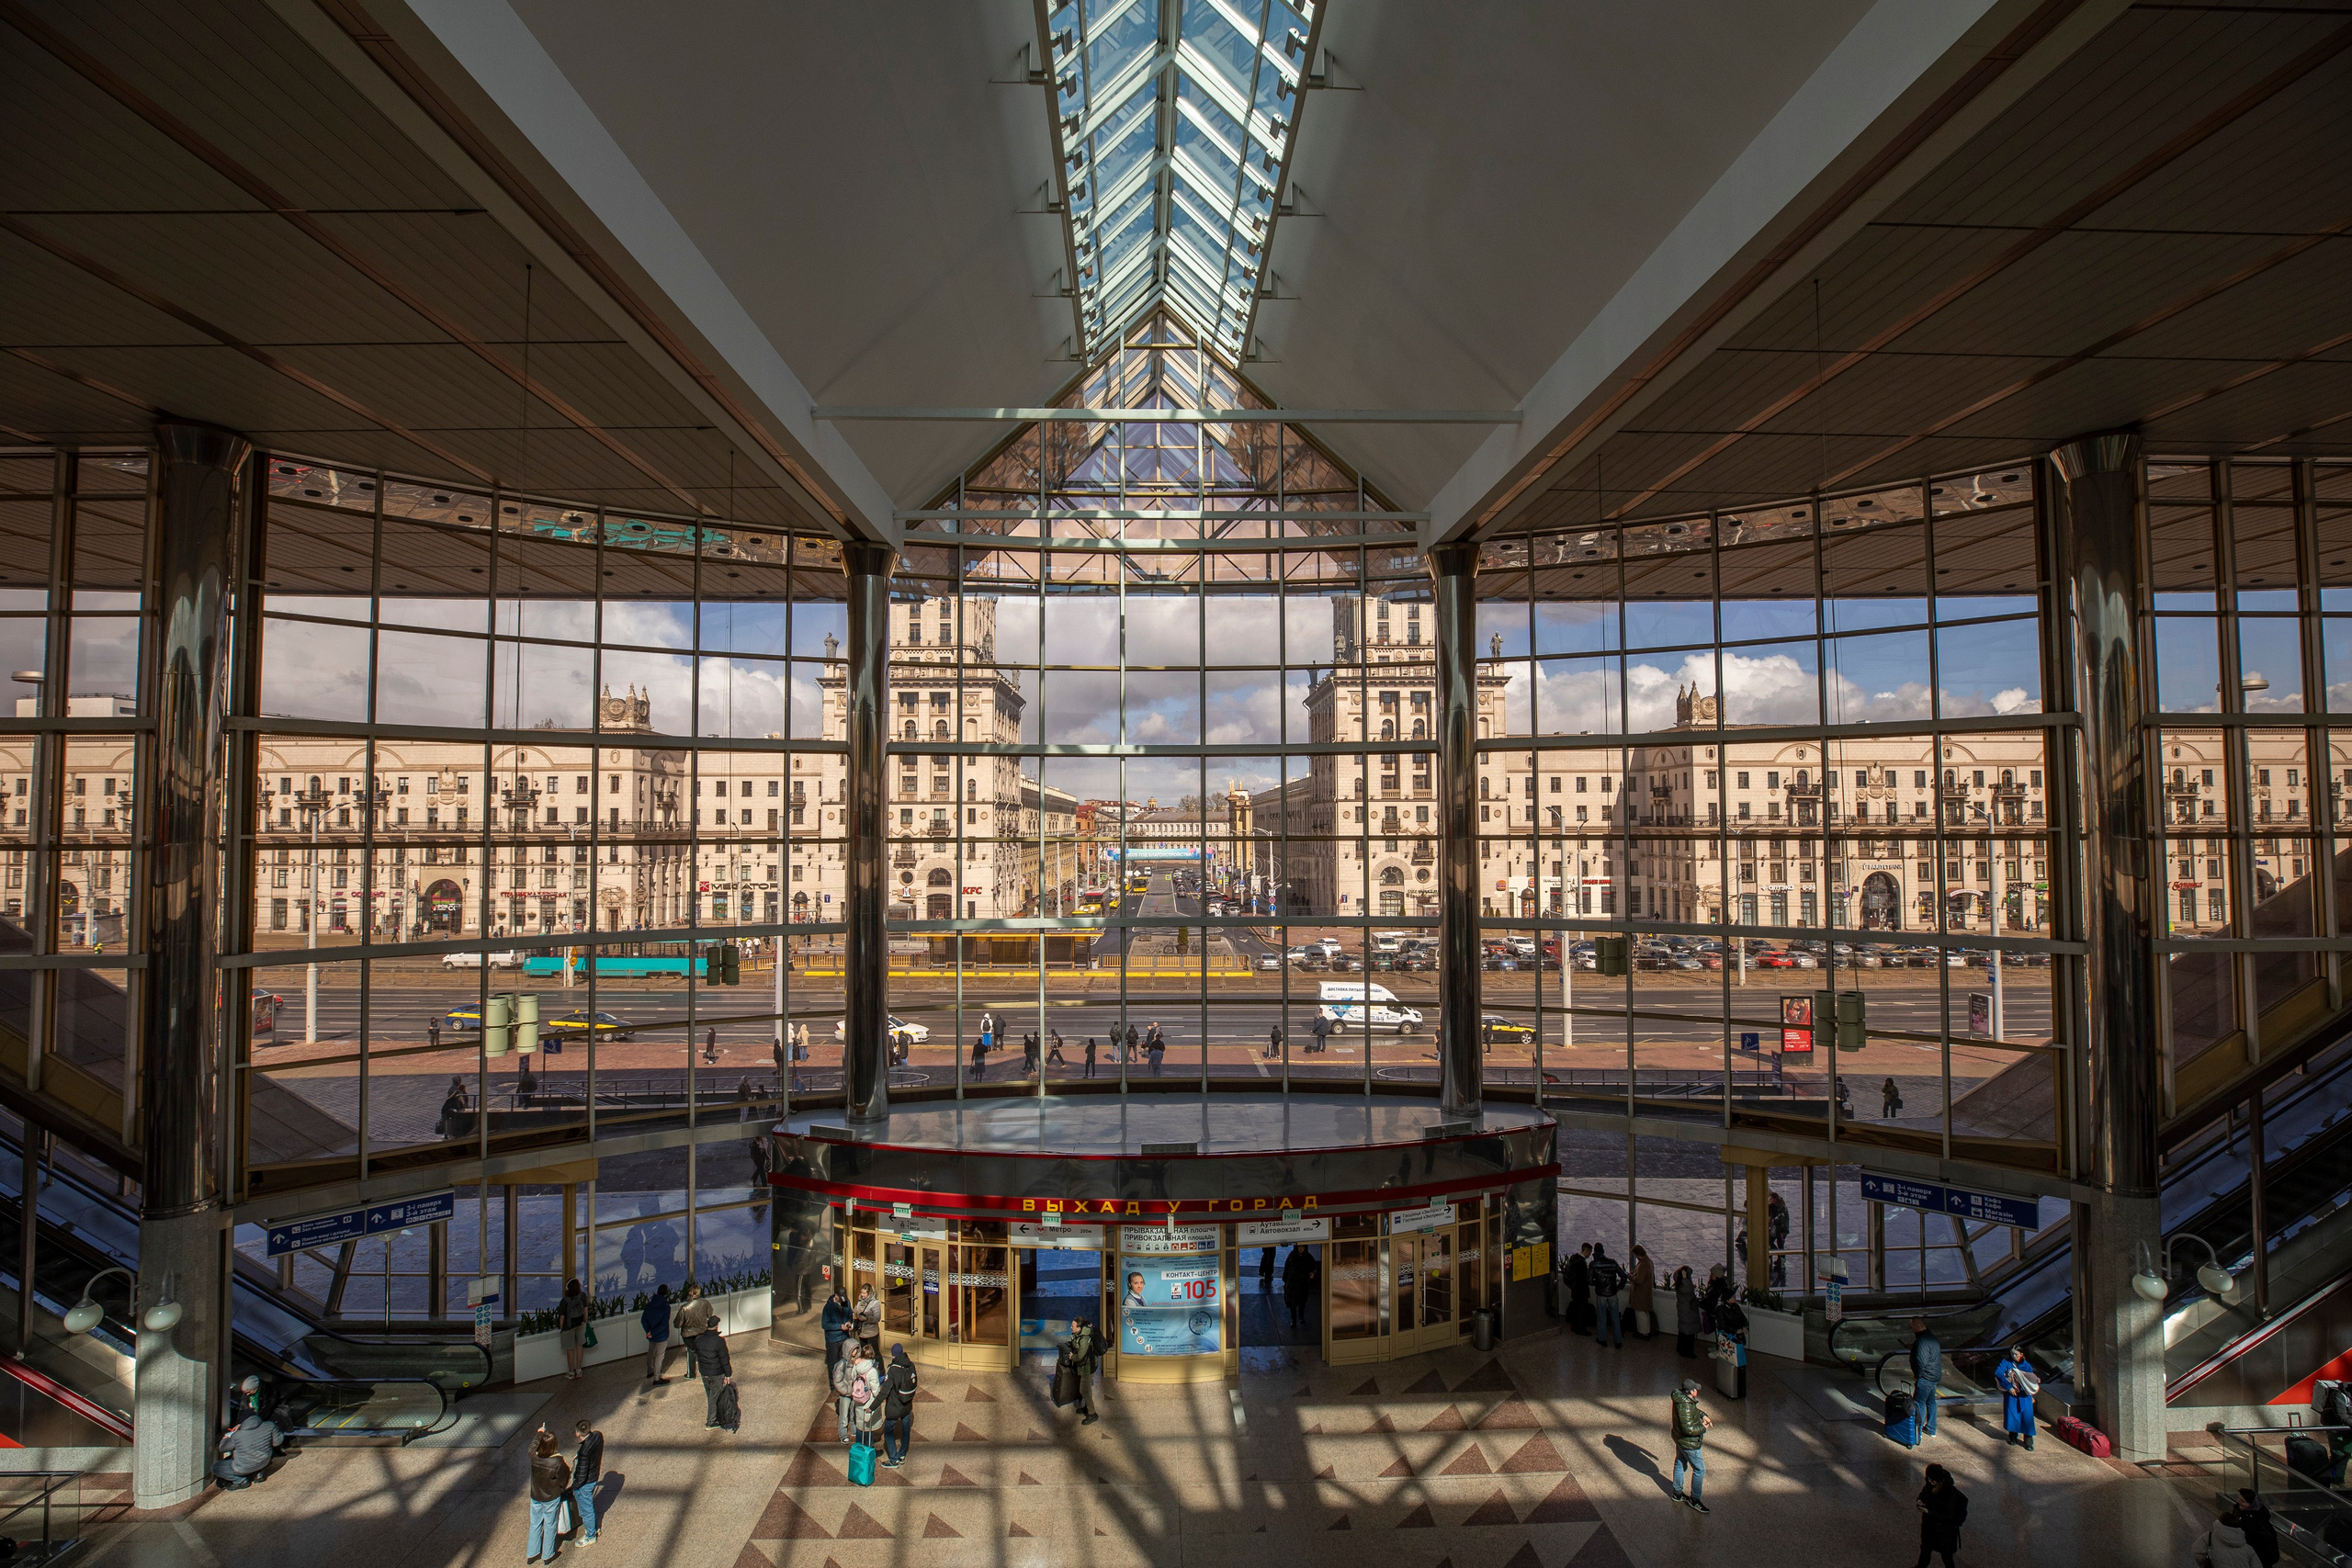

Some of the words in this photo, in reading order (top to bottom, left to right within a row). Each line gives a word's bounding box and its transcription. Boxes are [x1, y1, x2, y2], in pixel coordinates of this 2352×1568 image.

[961, 886, 982, 895] KFC
[417, 1200, 443, 1209] паверх
[1023, 1199, 1140, 1216] ВЫХАД
[1168, 1201, 1181, 1213] У
[1208, 1195, 1317, 1213] ГОРАД
[1984, 1201, 2002, 1210] Кафе
[419, 1206, 437, 1214] этаж
[1984, 1208, 2013, 1218] Магазін
[1984, 1213, 2016, 1224] Магазин
[1166, 1269, 1218, 1278] КОНТАКТ-ЦЕНТР
[1183, 1280, 1216, 1300] 105
